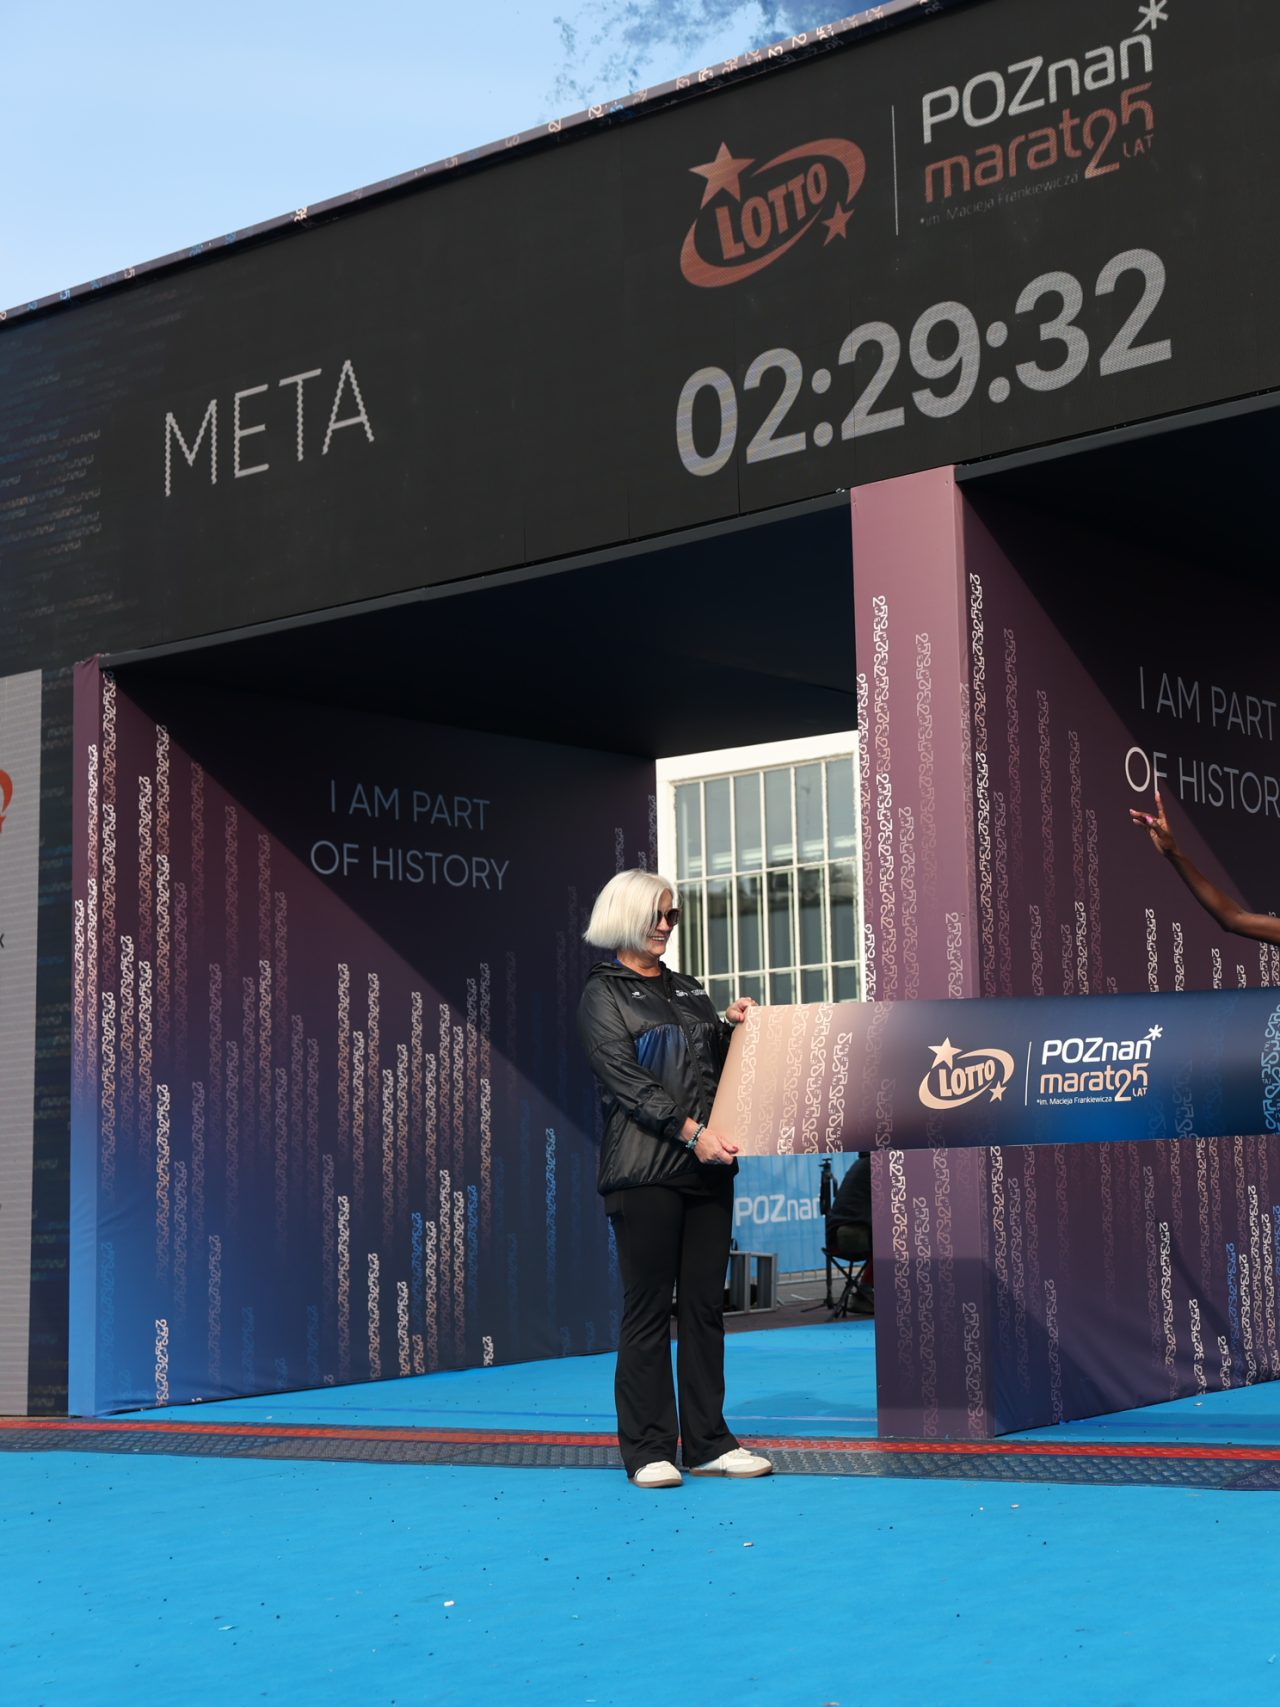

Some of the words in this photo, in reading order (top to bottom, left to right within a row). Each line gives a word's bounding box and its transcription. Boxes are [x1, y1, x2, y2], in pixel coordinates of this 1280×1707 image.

[715, 161, 827, 260] LOTTO
[676, 249, 1172, 476] 02:29:32
[165, 360, 375, 497] META
[1140, 666, 1145, 710] I
[1157, 672, 1201, 723] AM
[1211, 685, 1277, 741] PART
[1125, 746, 1168, 793] OF
[331, 779, 336, 813] I
[349, 783, 400, 820] AM
[413, 790, 491, 830] PART
[311, 840, 359, 876] OF
[373, 846, 510, 891] HISTORY
[938, 1059, 996, 1098] LOTTO
